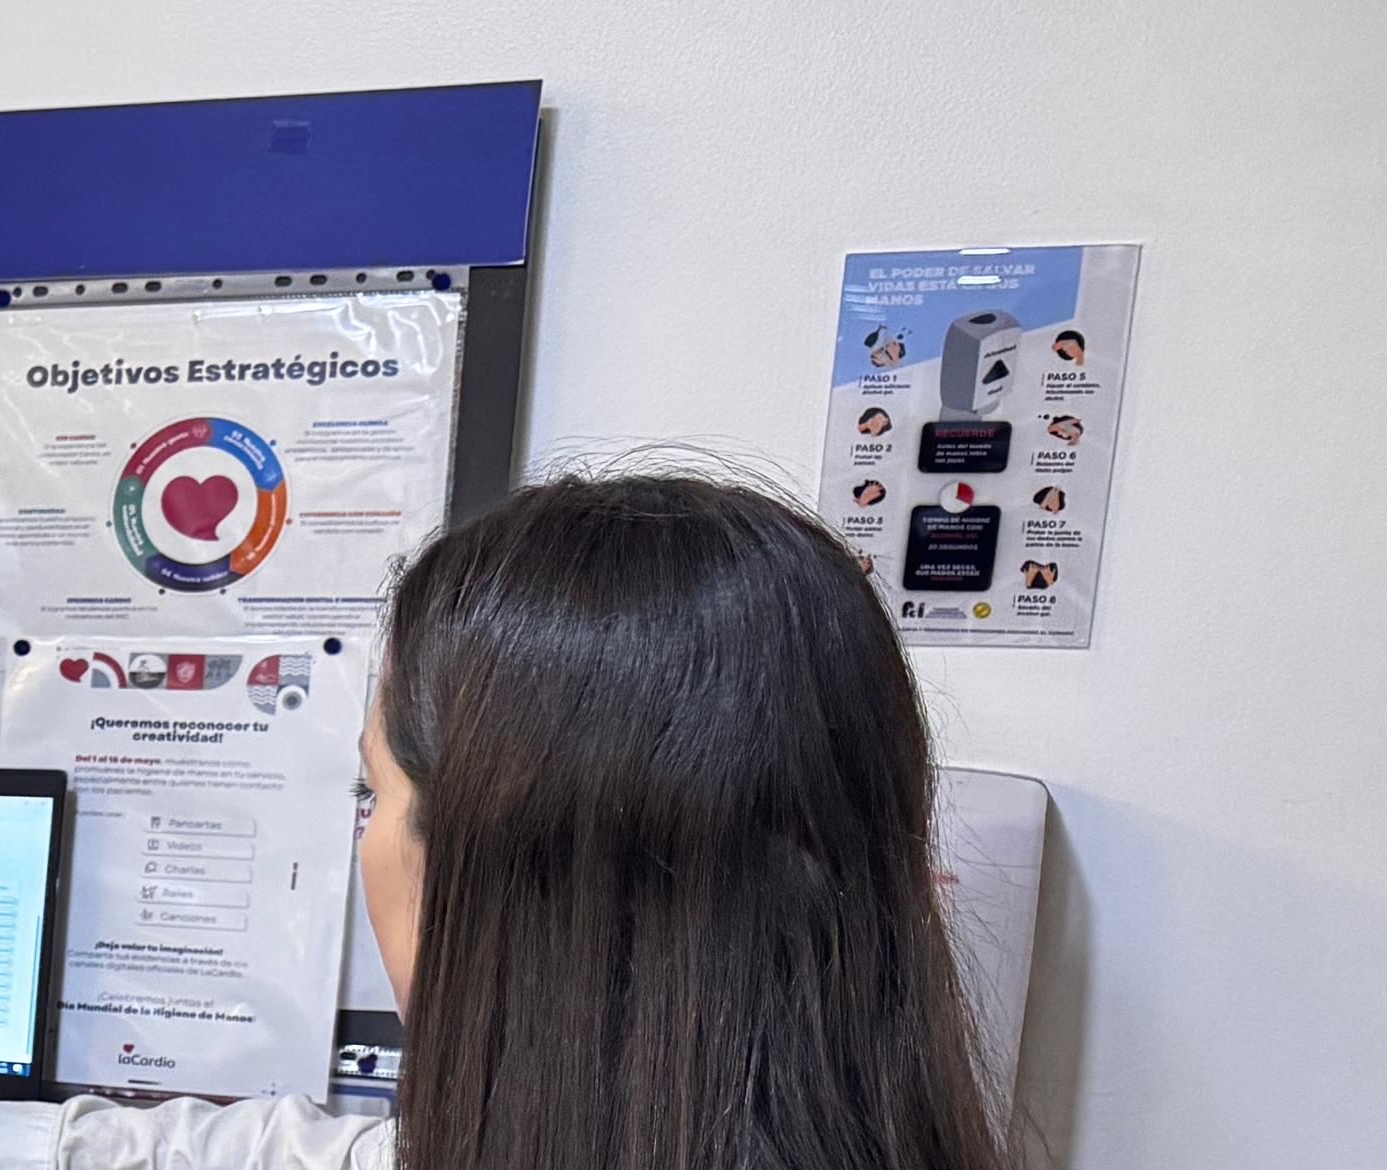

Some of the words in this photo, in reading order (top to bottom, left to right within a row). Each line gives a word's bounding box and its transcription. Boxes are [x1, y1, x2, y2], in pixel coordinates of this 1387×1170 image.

[869, 268, 887, 279] EL
[891, 267, 944, 278] PODER
[868, 281, 915, 292] VIDAS
[27, 359, 179, 393] Objetivos
[187, 351, 399, 386] Estratégicos
[1048, 372, 1076, 380] PASO
[863, 375, 890, 383] PASO
[855, 444, 883, 452] PASO
[1038, 452, 1067, 460] PASO
[847, 516, 874, 524] PASO
[1018, 595, 1046, 604] PASO
[90, 716, 170, 731] ¡Queremos
[172, 719, 250, 732] reconocer
[253, 721, 269, 732] tu
[132, 731, 224, 744] creatividad!
[75, 755, 92, 763] Del
[168, 819, 223, 830] Pancartas
[165, 865, 206, 876] Charlas
[160, 911, 217, 924] Canciones
[76, 1002, 122, 1014] Mundial
[124, 1005, 139, 1015] de
[140, 1005, 151, 1016] la
[198, 1010, 213, 1020] de
[118, 1053, 176, 1069] laCardio
